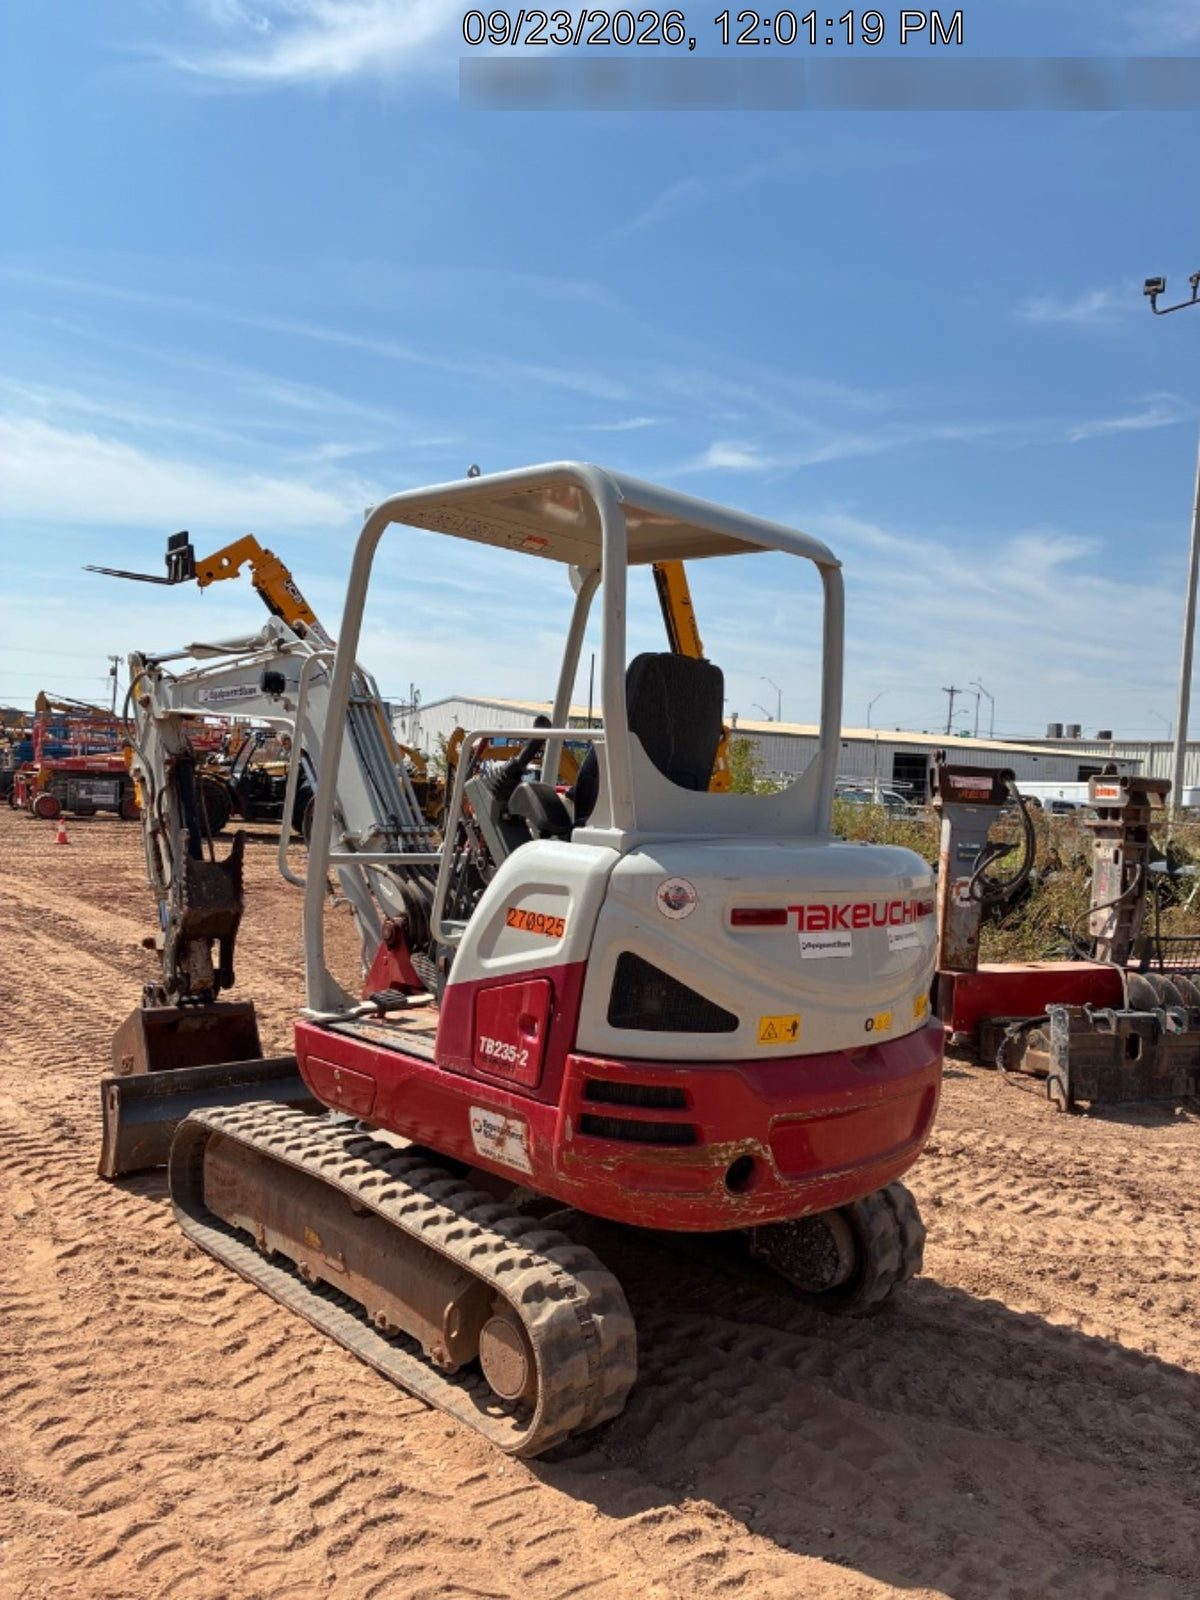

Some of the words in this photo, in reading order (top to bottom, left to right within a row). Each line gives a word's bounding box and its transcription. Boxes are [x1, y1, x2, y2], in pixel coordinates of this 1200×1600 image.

[506, 906, 566, 938] 270925
[787, 899, 918, 931] TAKEUCHI
[480, 1035, 529, 1067] TB235-2
